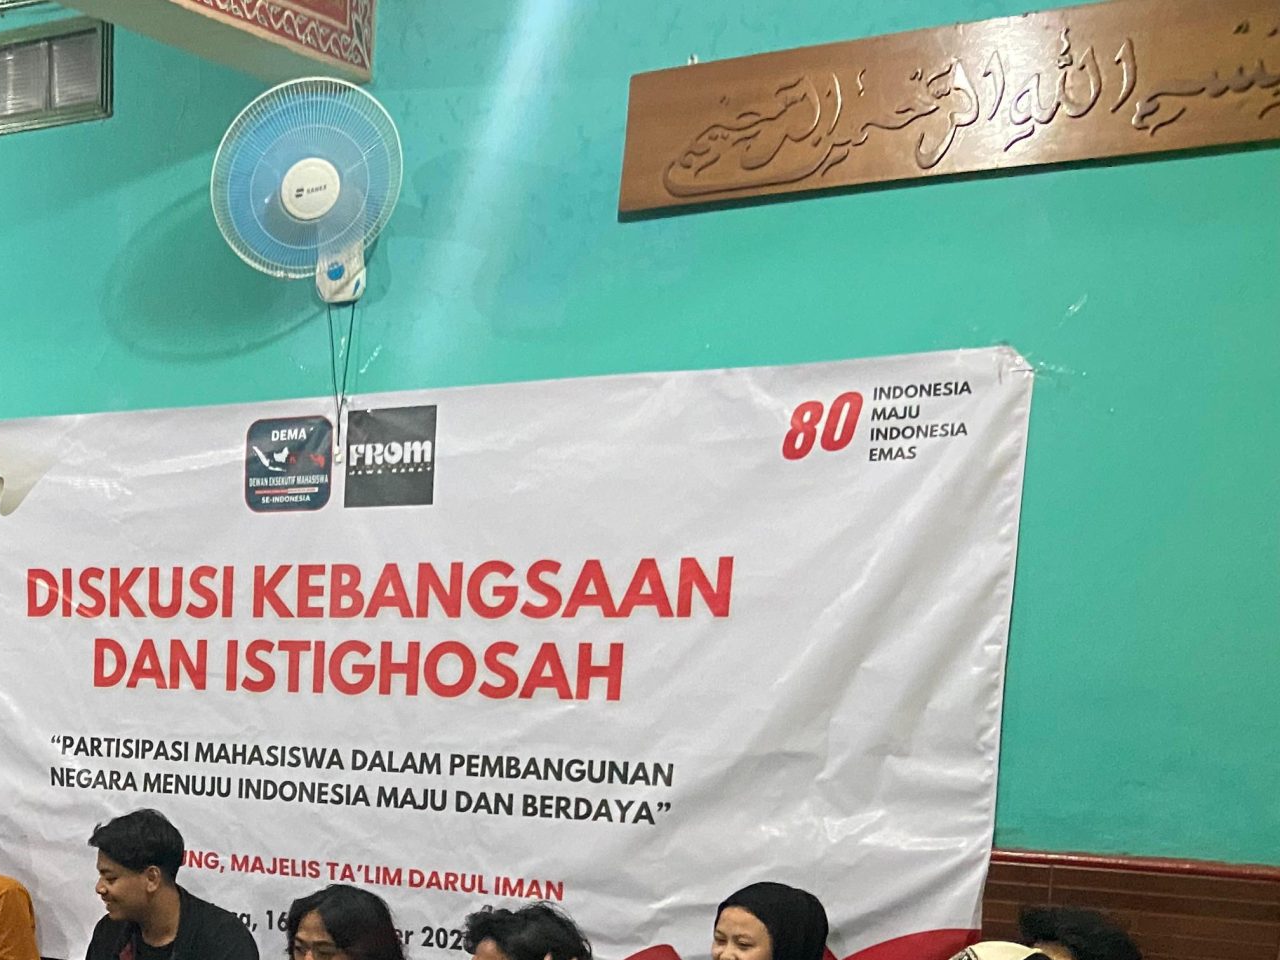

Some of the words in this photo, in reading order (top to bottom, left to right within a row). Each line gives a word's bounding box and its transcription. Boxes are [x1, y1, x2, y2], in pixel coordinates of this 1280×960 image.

[873, 381, 972, 401] INDONESIA
[271, 428, 307, 441] DEMA
[782, 391, 864, 460] 80
[870, 422, 968, 441] INDONESIA
[871, 405, 920, 422] MAJU
[869, 446, 917, 462] EMAS
[27, 565, 234, 618] DISKUSI
[253, 556, 734, 619] KEBANGSAAN
[93, 638, 207, 690] DAN
[226, 639, 624, 701] ISTIGHOSAH
[51, 736, 188, 762] “PARTISIPASI
[195, 742, 344, 770] MAHASISWA
[351, 749, 441, 776] DALAM
[449, 754, 674, 787] PEMBANGUNAN
[50, 767, 137, 792] NEGARA
[143, 772, 231, 798] MENUJU
[238, 778, 370, 807] INDONESIA
[376, 786, 447, 812] MAJU
[455, 791, 514, 816] DAN
[522, 795, 671, 825] BERDAYA”
[231, 854, 320, 878] MAJELIS
[326, 862, 402, 886] TA’LIM
[408, 869, 488, 894] DARUL
[494, 876, 564, 901] IMAN
[266, 910, 289, 932] 16
[421, 926, 463, 950] 202
